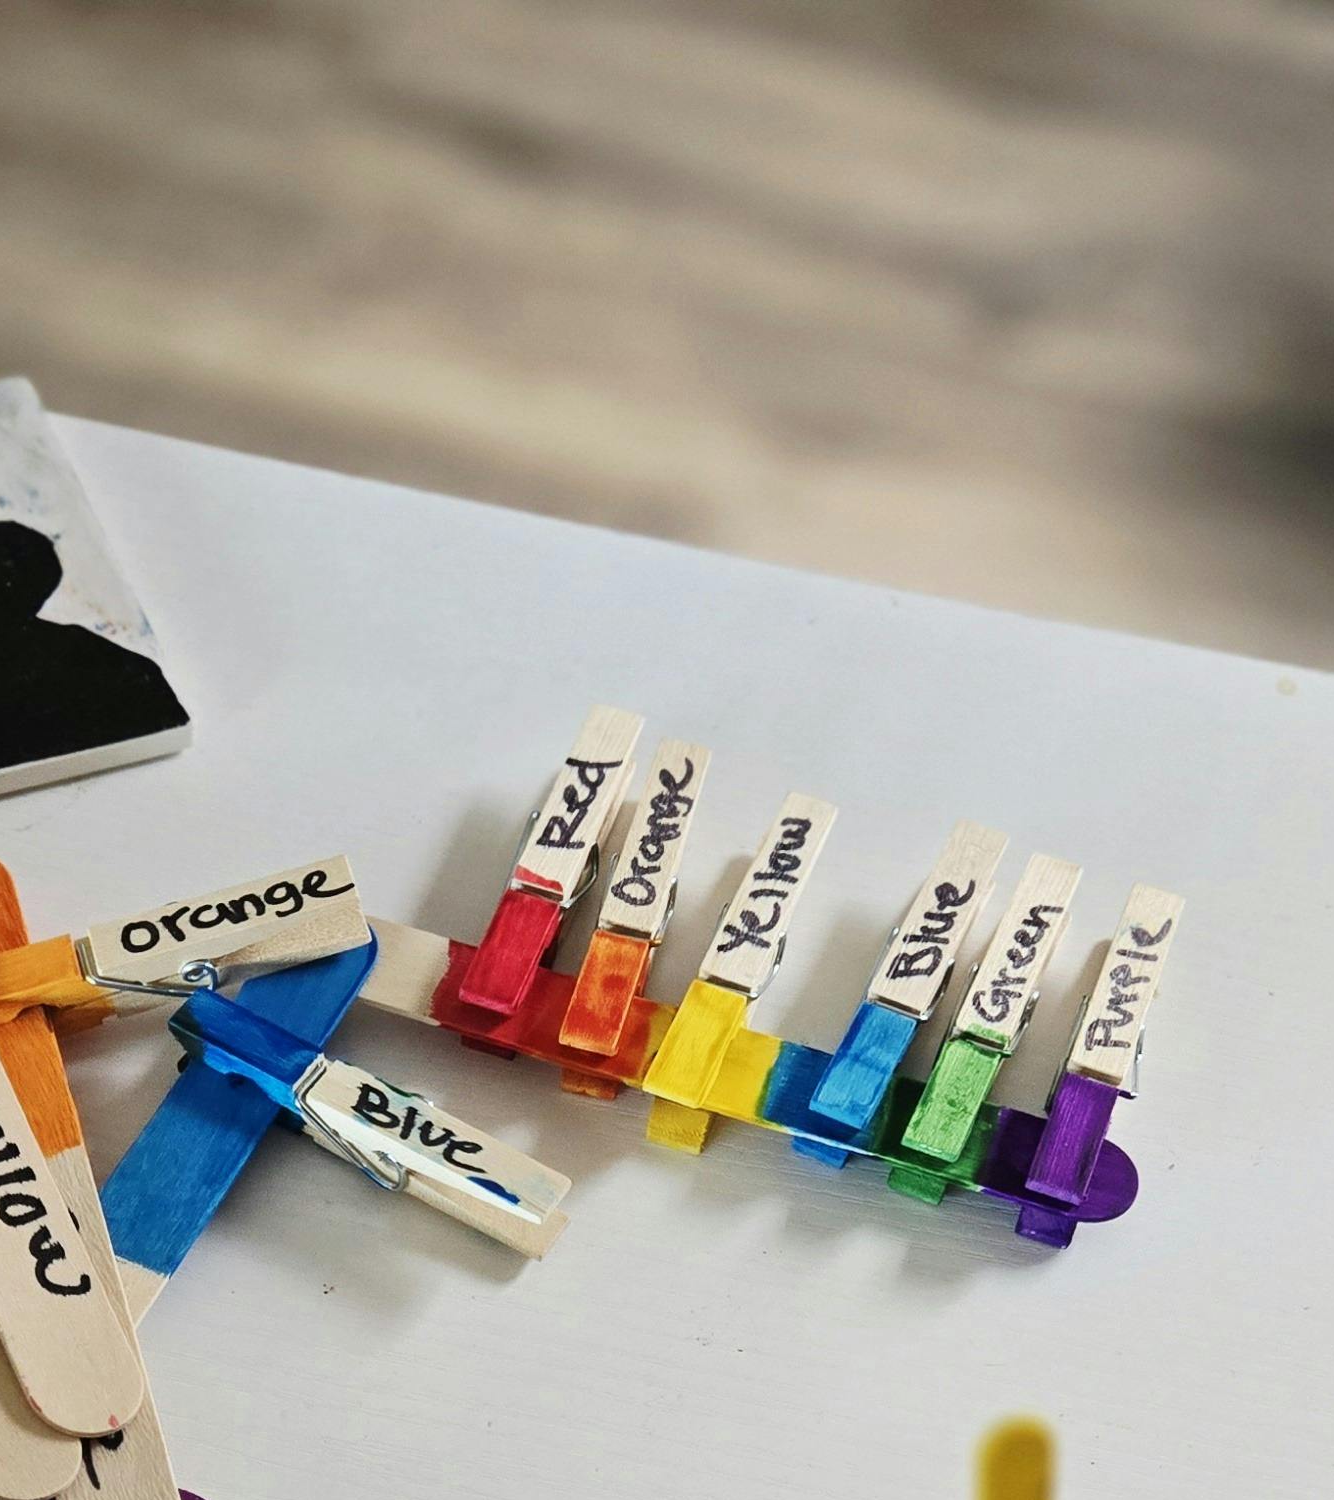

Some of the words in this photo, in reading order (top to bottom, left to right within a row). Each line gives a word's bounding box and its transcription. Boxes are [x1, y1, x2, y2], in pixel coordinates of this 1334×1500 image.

[536, 756, 624, 851] Red
[610, 756, 694, 908] Orange
[717, 816, 813, 955] Yellow
[886, 877, 976, 983] Blue
[971, 901, 1064, 1022] Green
[1084, 916, 1173, 1053] Purple
[349, 1081, 486, 1175] Blue
